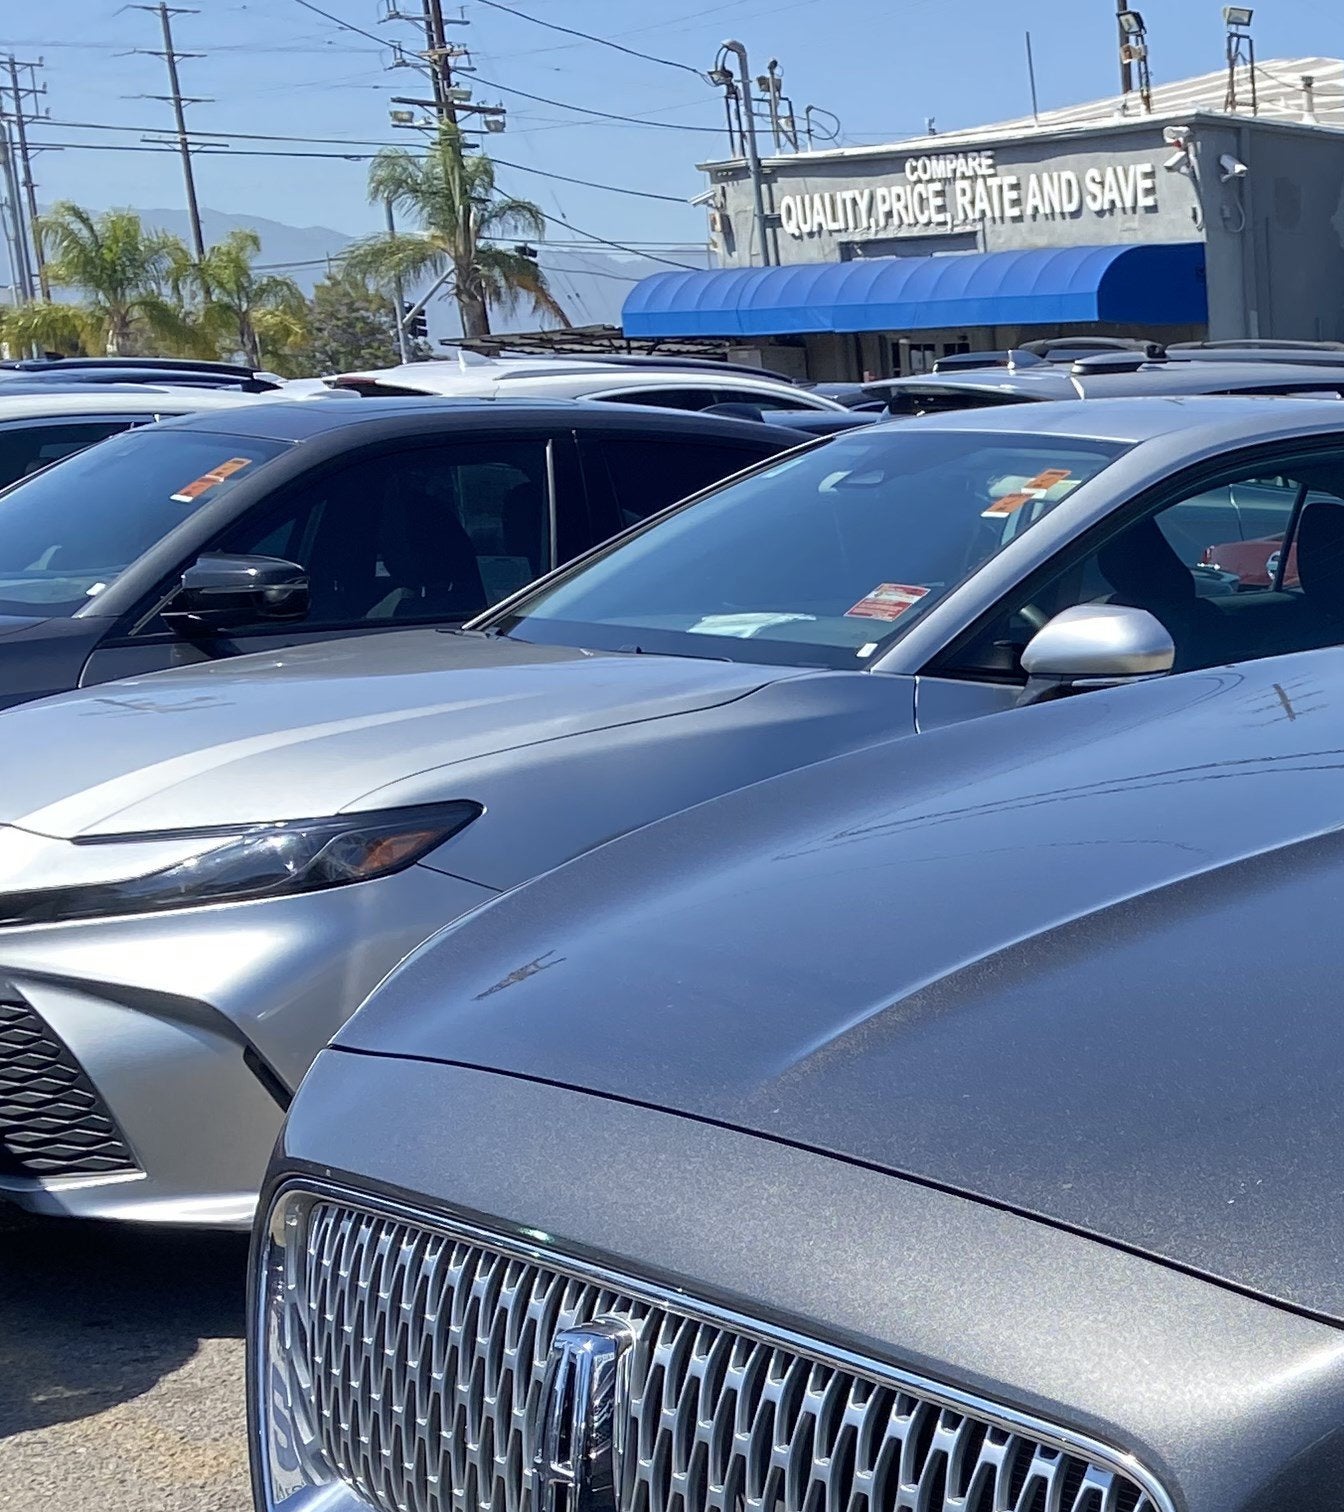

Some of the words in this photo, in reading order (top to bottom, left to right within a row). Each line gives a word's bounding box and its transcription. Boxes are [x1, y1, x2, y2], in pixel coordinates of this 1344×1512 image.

[904, 151, 996, 182] COMPARE
[780, 188, 876, 238] QUALITY,
[876, 181, 953, 231] PRICE,
[955, 175, 1022, 221] RATE
[1026, 170, 1081, 216] AND
[1084, 163, 1157, 212] SAVE
